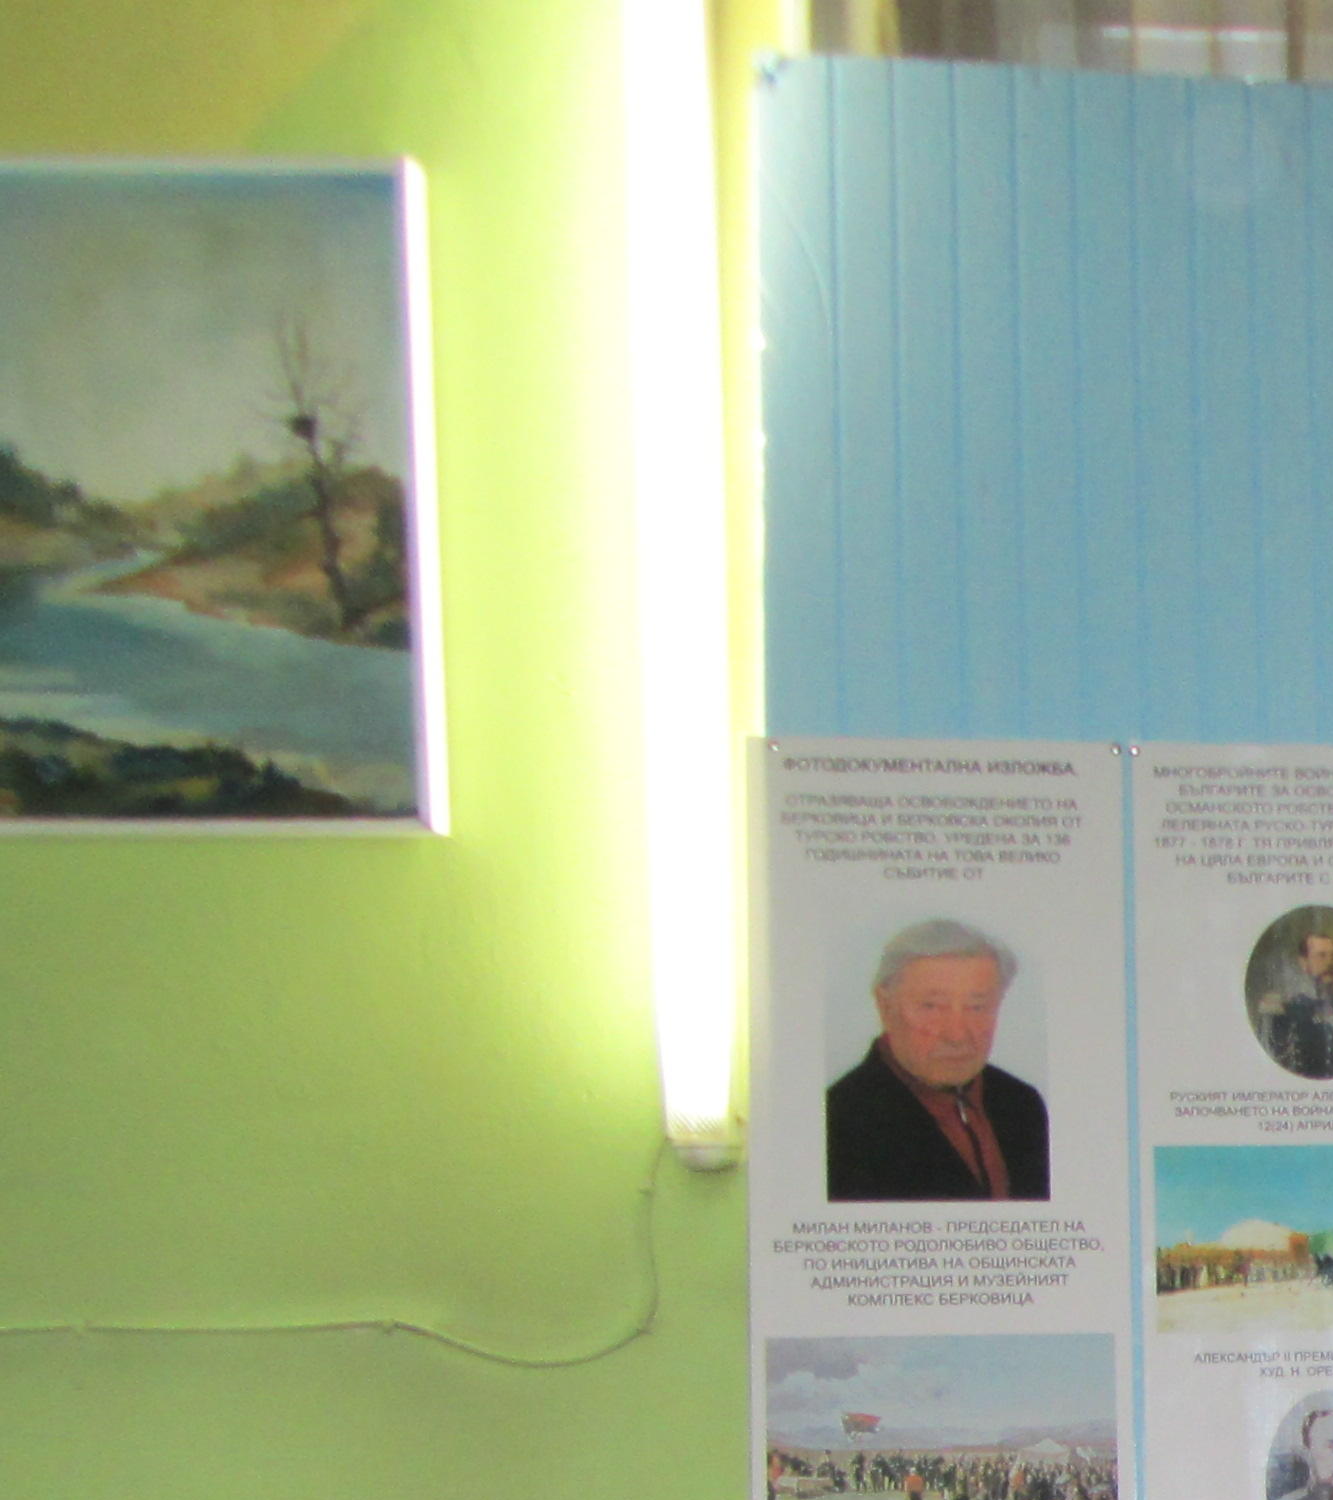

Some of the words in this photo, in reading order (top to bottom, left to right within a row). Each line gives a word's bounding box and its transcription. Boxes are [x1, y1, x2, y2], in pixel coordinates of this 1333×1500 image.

[792, 1222, 849, 1234] МИЛАН
[853, 1221, 932, 1233] МИЛАНОВ
[945, 1221, 1059, 1235] ПРЕДСЕДАТЕЛ
[1063, 1221, 1085, 1233] НА
[772, 1240, 889, 1252] БЕРКОВСКОТО
[893, 1239, 1007, 1253] РОДОЛЮБИВО
[803, 1257, 827, 1269] ПО
[830, 1257, 938, 1271] ИНИЦИАТИВА
[941, 1257, 964, 1269] НА
[968, 1257, 1075, 1270] ОБЩИНСКАТА
[810, 1274, 953, 1289] АДМИНИСТРАЦИЯ
[957, 1274, 968, 1286] И
[972, 1272, 1067, 1286] МУЗЕЙНИЯТ
[847, 1293, 933, 1306] КОМПЛЕКС
[938, 1292, 1033, 1307] БЕРКОВИЦА
